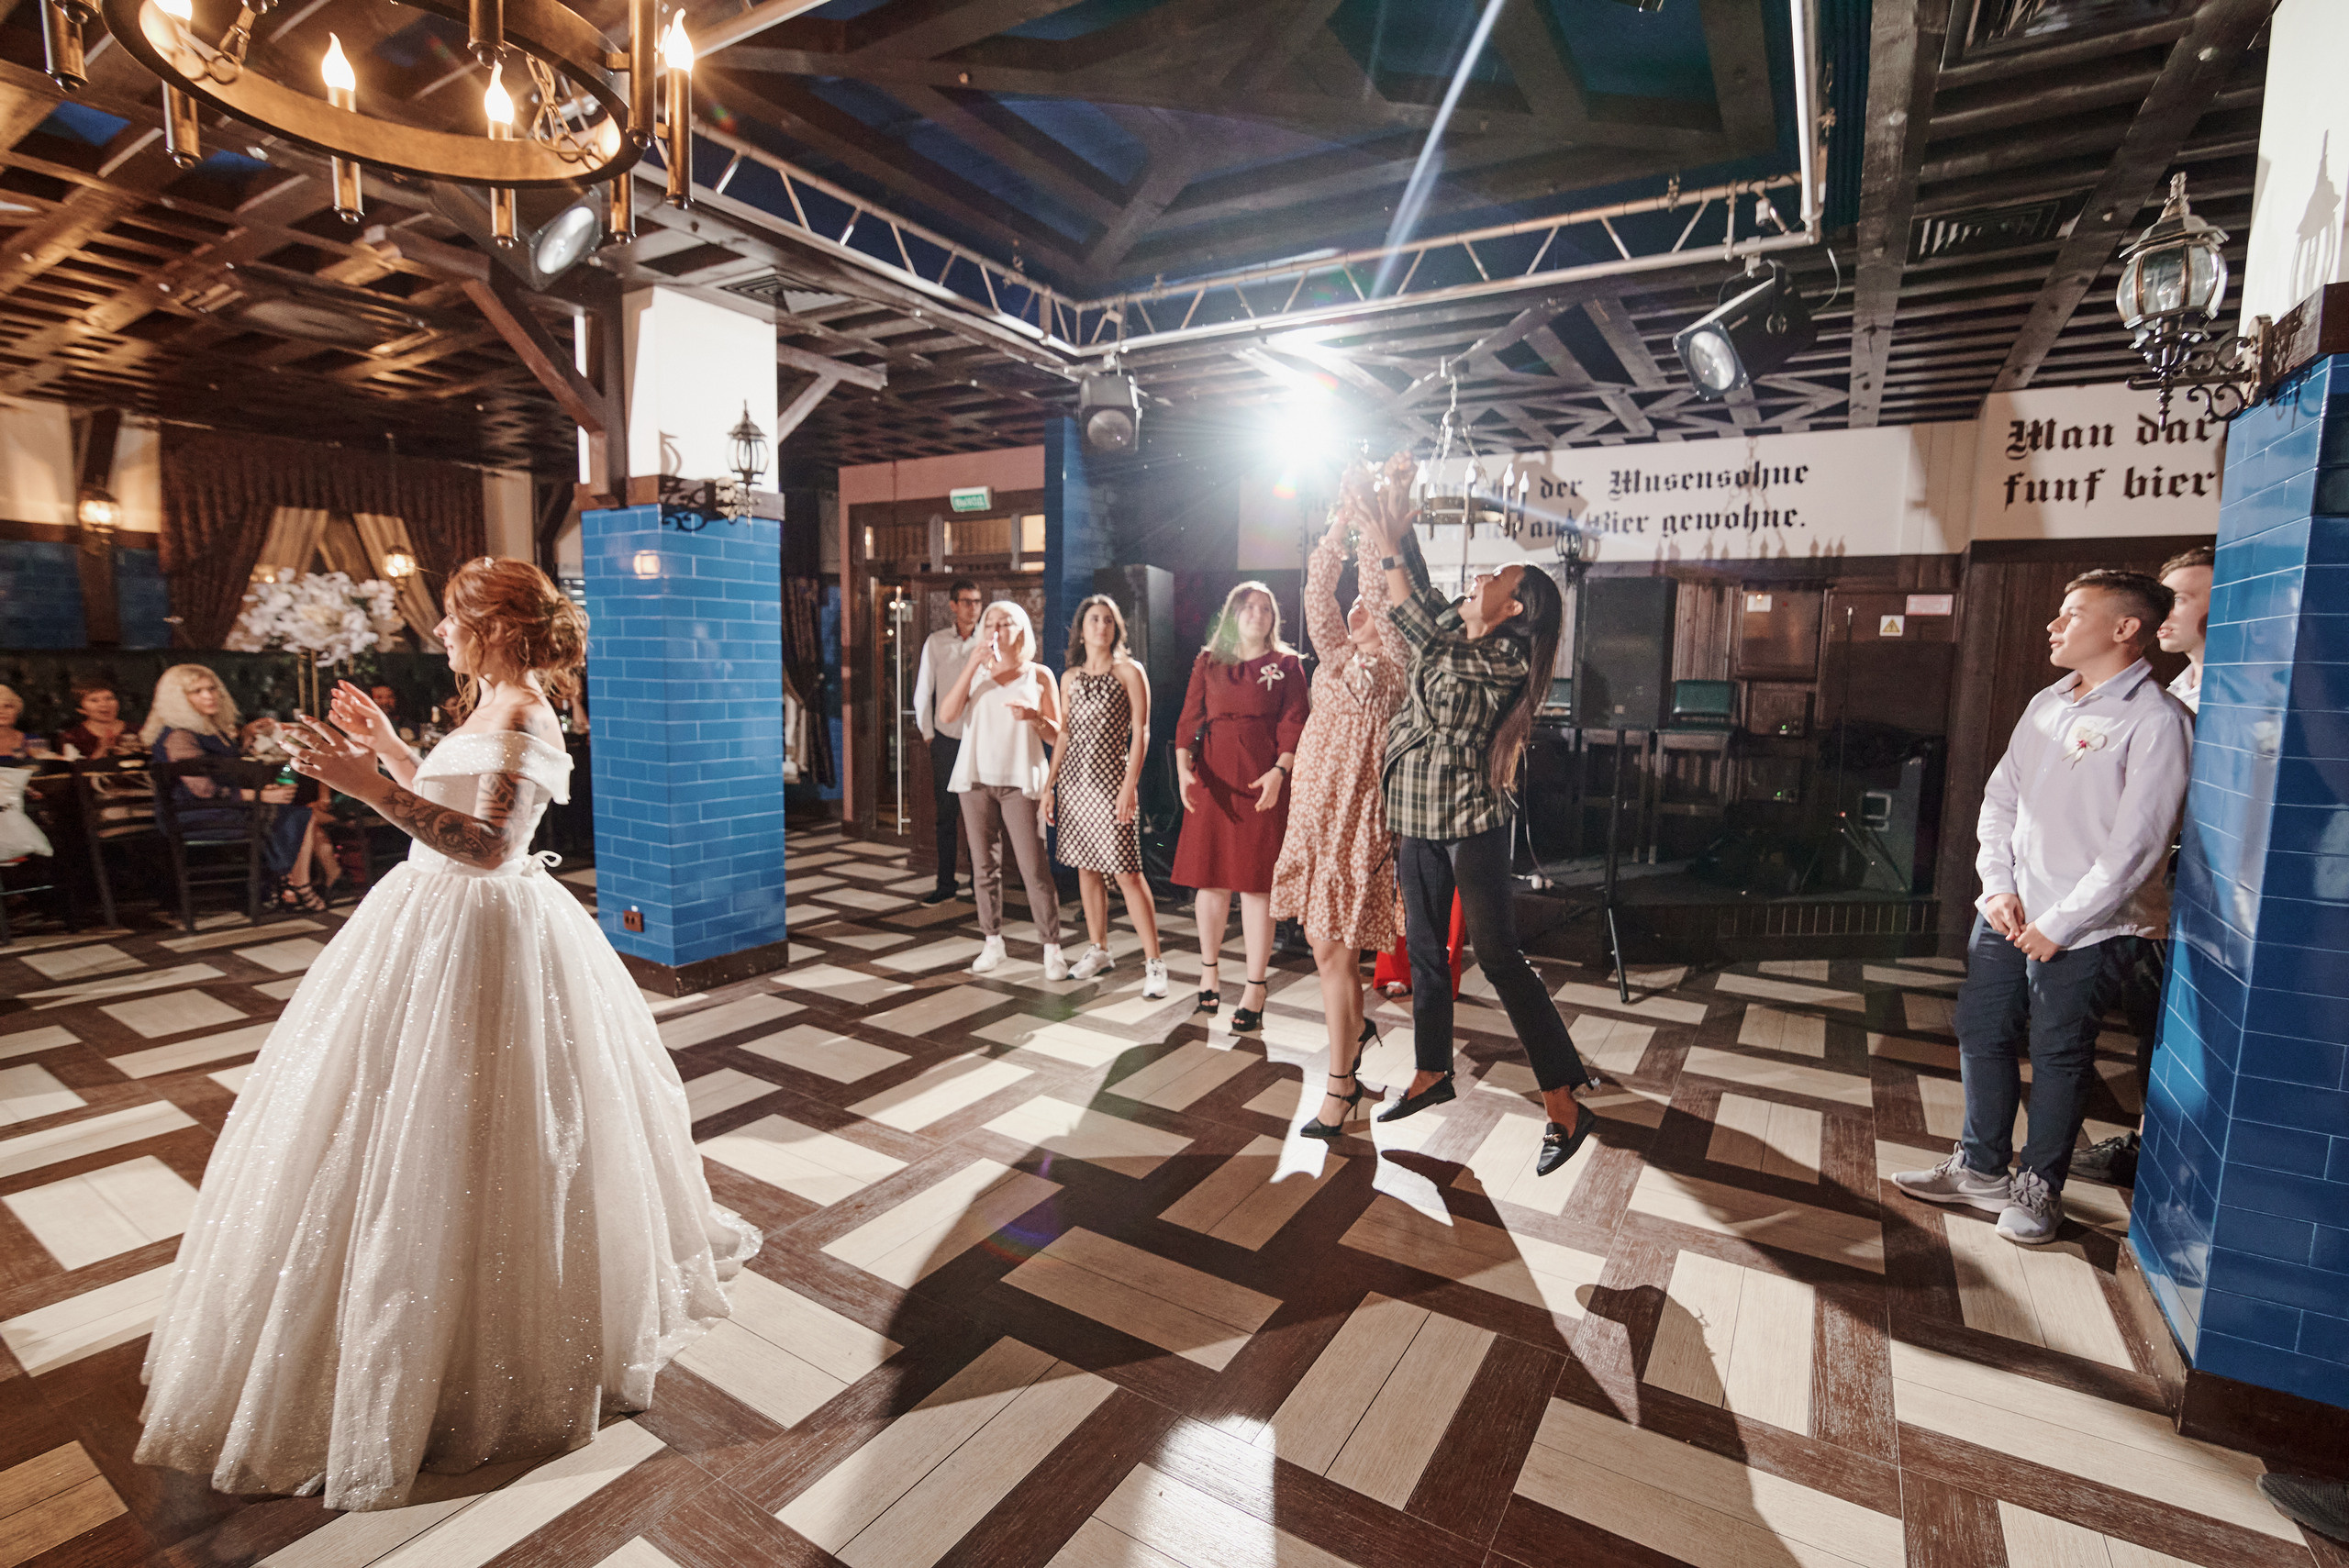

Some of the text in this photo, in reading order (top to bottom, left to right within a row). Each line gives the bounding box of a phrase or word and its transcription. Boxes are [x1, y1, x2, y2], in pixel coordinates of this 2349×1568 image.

[2006, 418, 2115, 460] Man
[1540, 475, 1582, 499] der
[1609, 461, 1809, 500] Musensohne
[2004, 466, 2216, 511] funf bier
[1662, 504, 1806, 538] gewohne.
